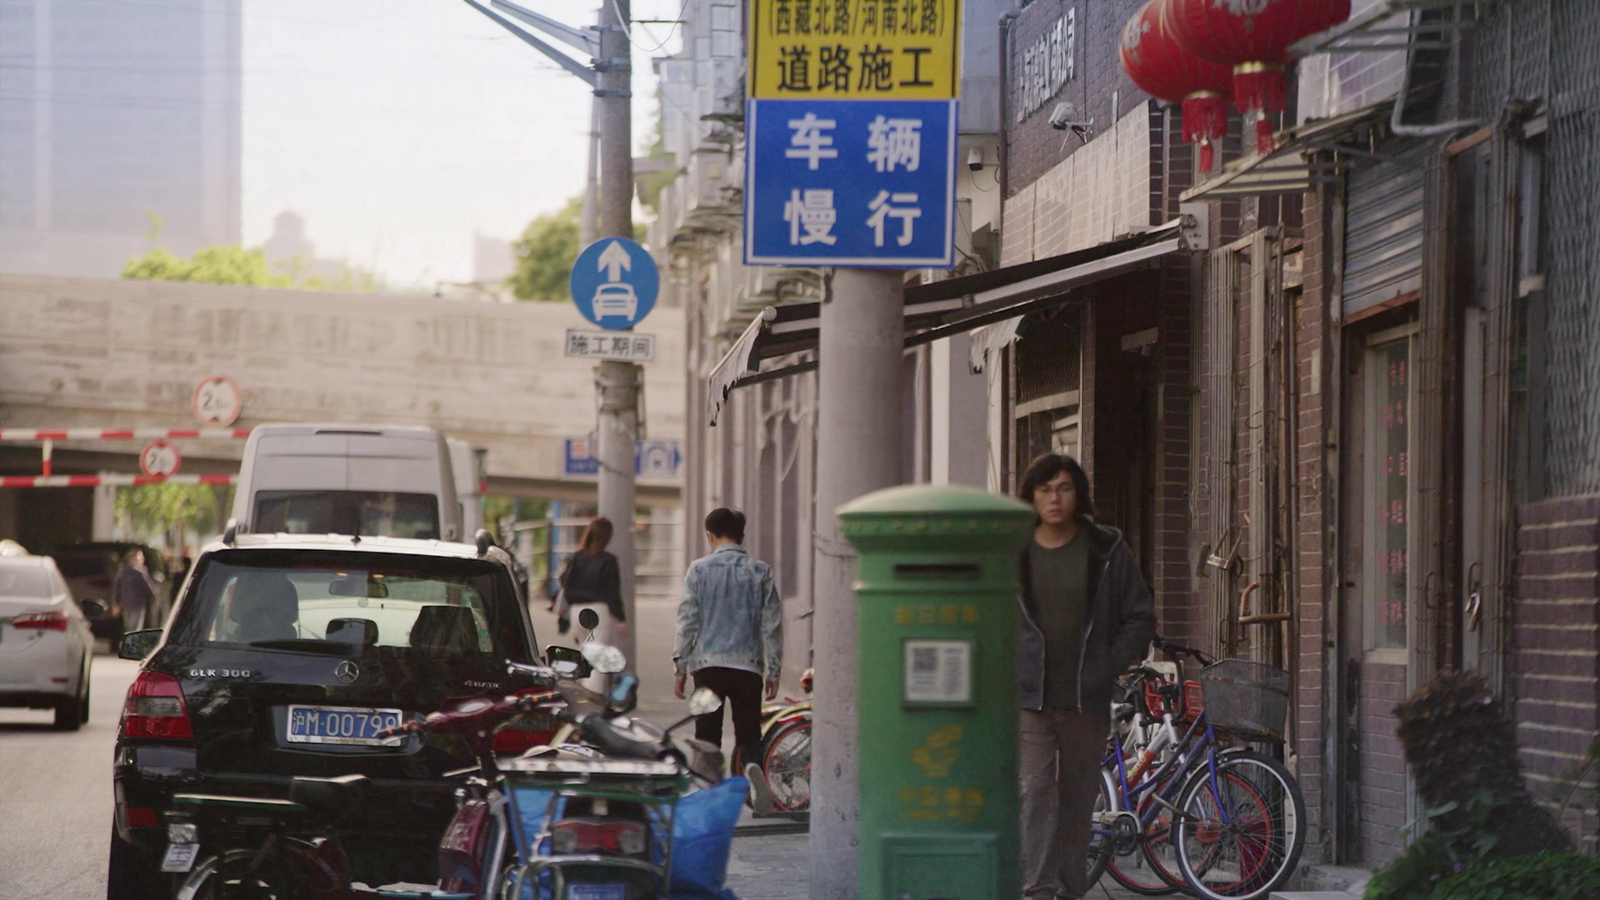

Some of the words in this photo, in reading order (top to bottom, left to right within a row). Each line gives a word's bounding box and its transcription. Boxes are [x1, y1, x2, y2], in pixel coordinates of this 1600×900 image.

[777, 44, 935, 92] 道路施工
[785, 112, 923, 173] 车辆
[783, 188, 922, 247] 慢行
[569, 335, 651, 358] 施工期间
[190, 669, 216, 677] GLK
[221, 669, 250, 678] 300
